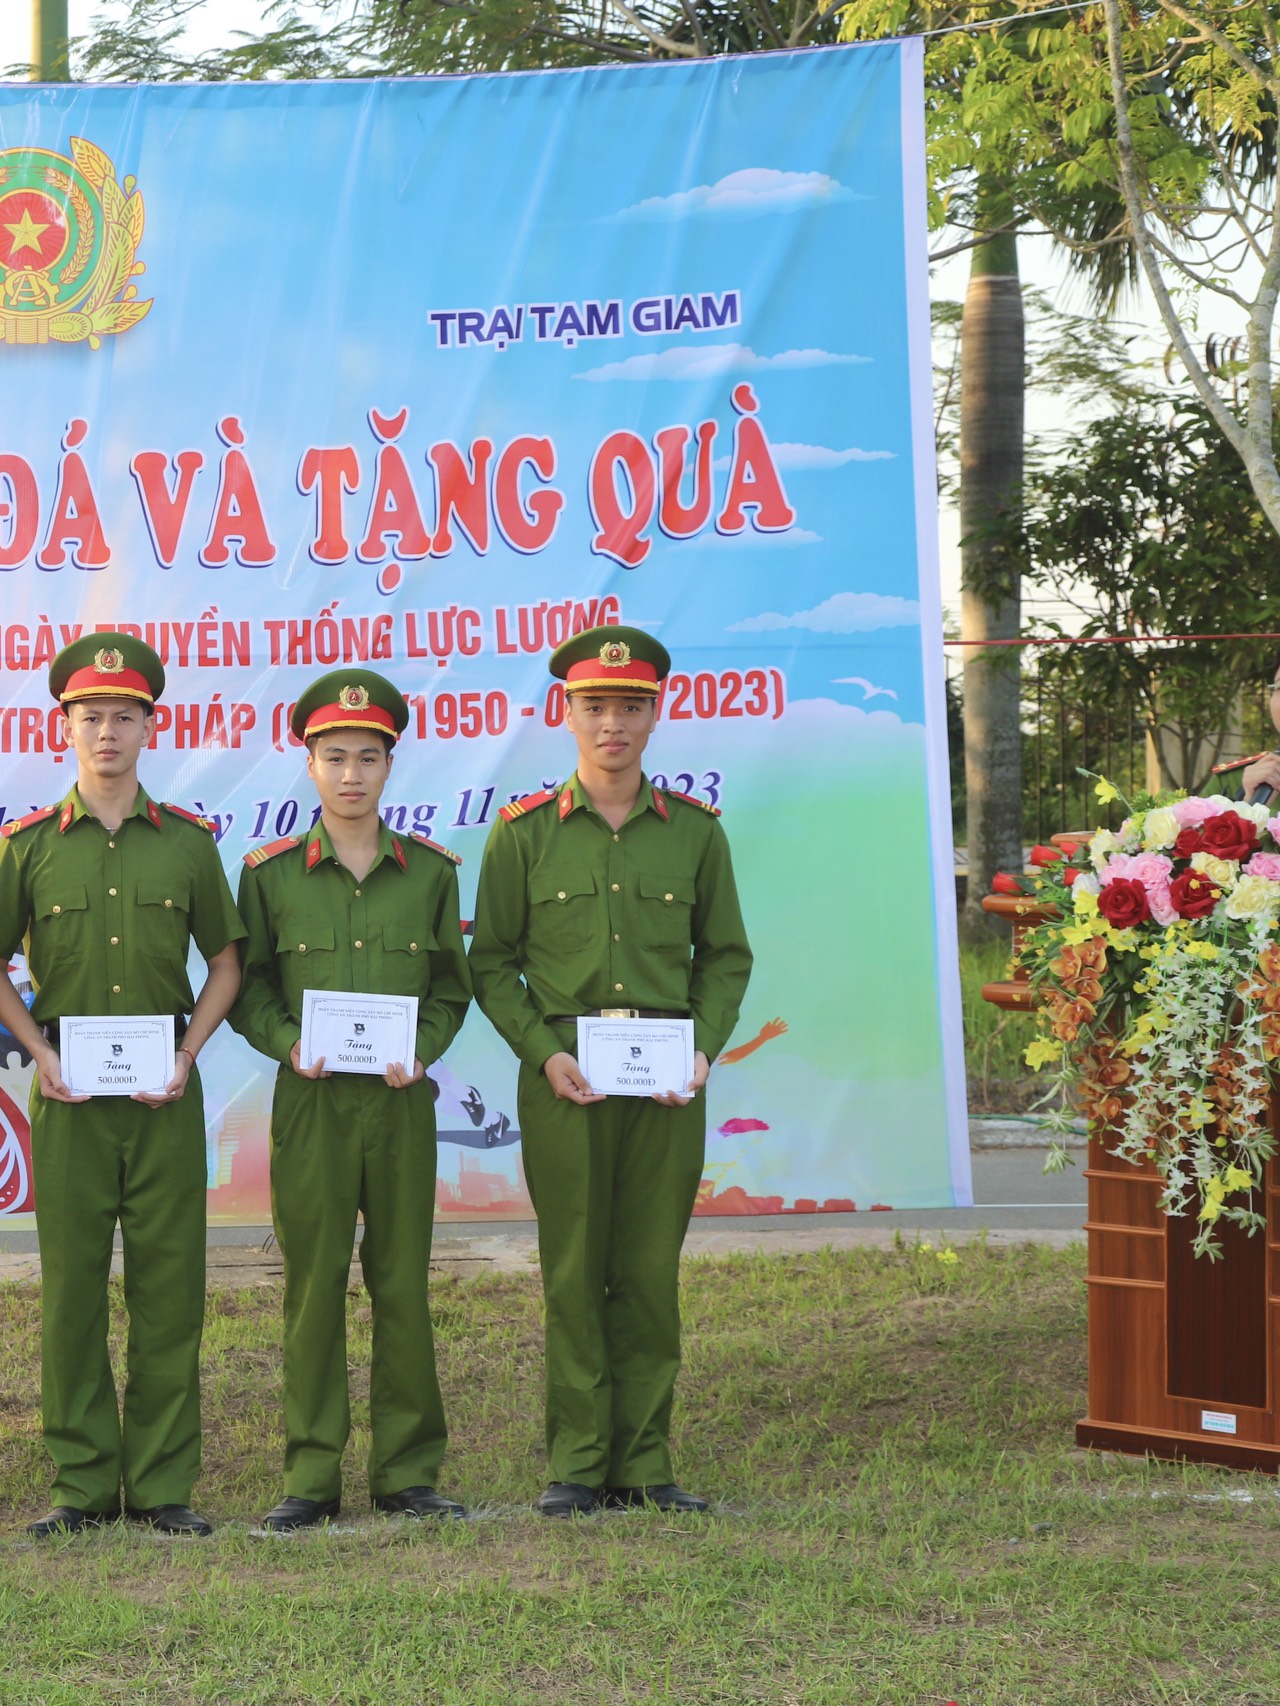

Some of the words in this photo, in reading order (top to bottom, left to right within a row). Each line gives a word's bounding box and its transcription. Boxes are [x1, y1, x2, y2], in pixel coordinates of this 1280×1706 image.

[431, 304, 522, 348] TRẠI
[531, 301, 620, 345] TẠM
[632, 293, 738, 332] GIAM
[134, 418, 274, 562] VÀ
[303, 411, 561, 588] TẶNG
[594, 386, 792, 563] QUÀ
[95, 606, 251, 667] UYỀN
[266, 603, 392, 664] THỐNG
[407, 608, 480, 666] LỰC
[148, 694, 256, 750] PHÁP
[251, 800, 298, 839] 10
[455, 787, 495, 827] 11
[97, 1076, 137, 1084] 500.000Đ
[337, 1054, 377, 1064] 500.000Đ
[616, 1077, 656, 1086] 500.000Đ
